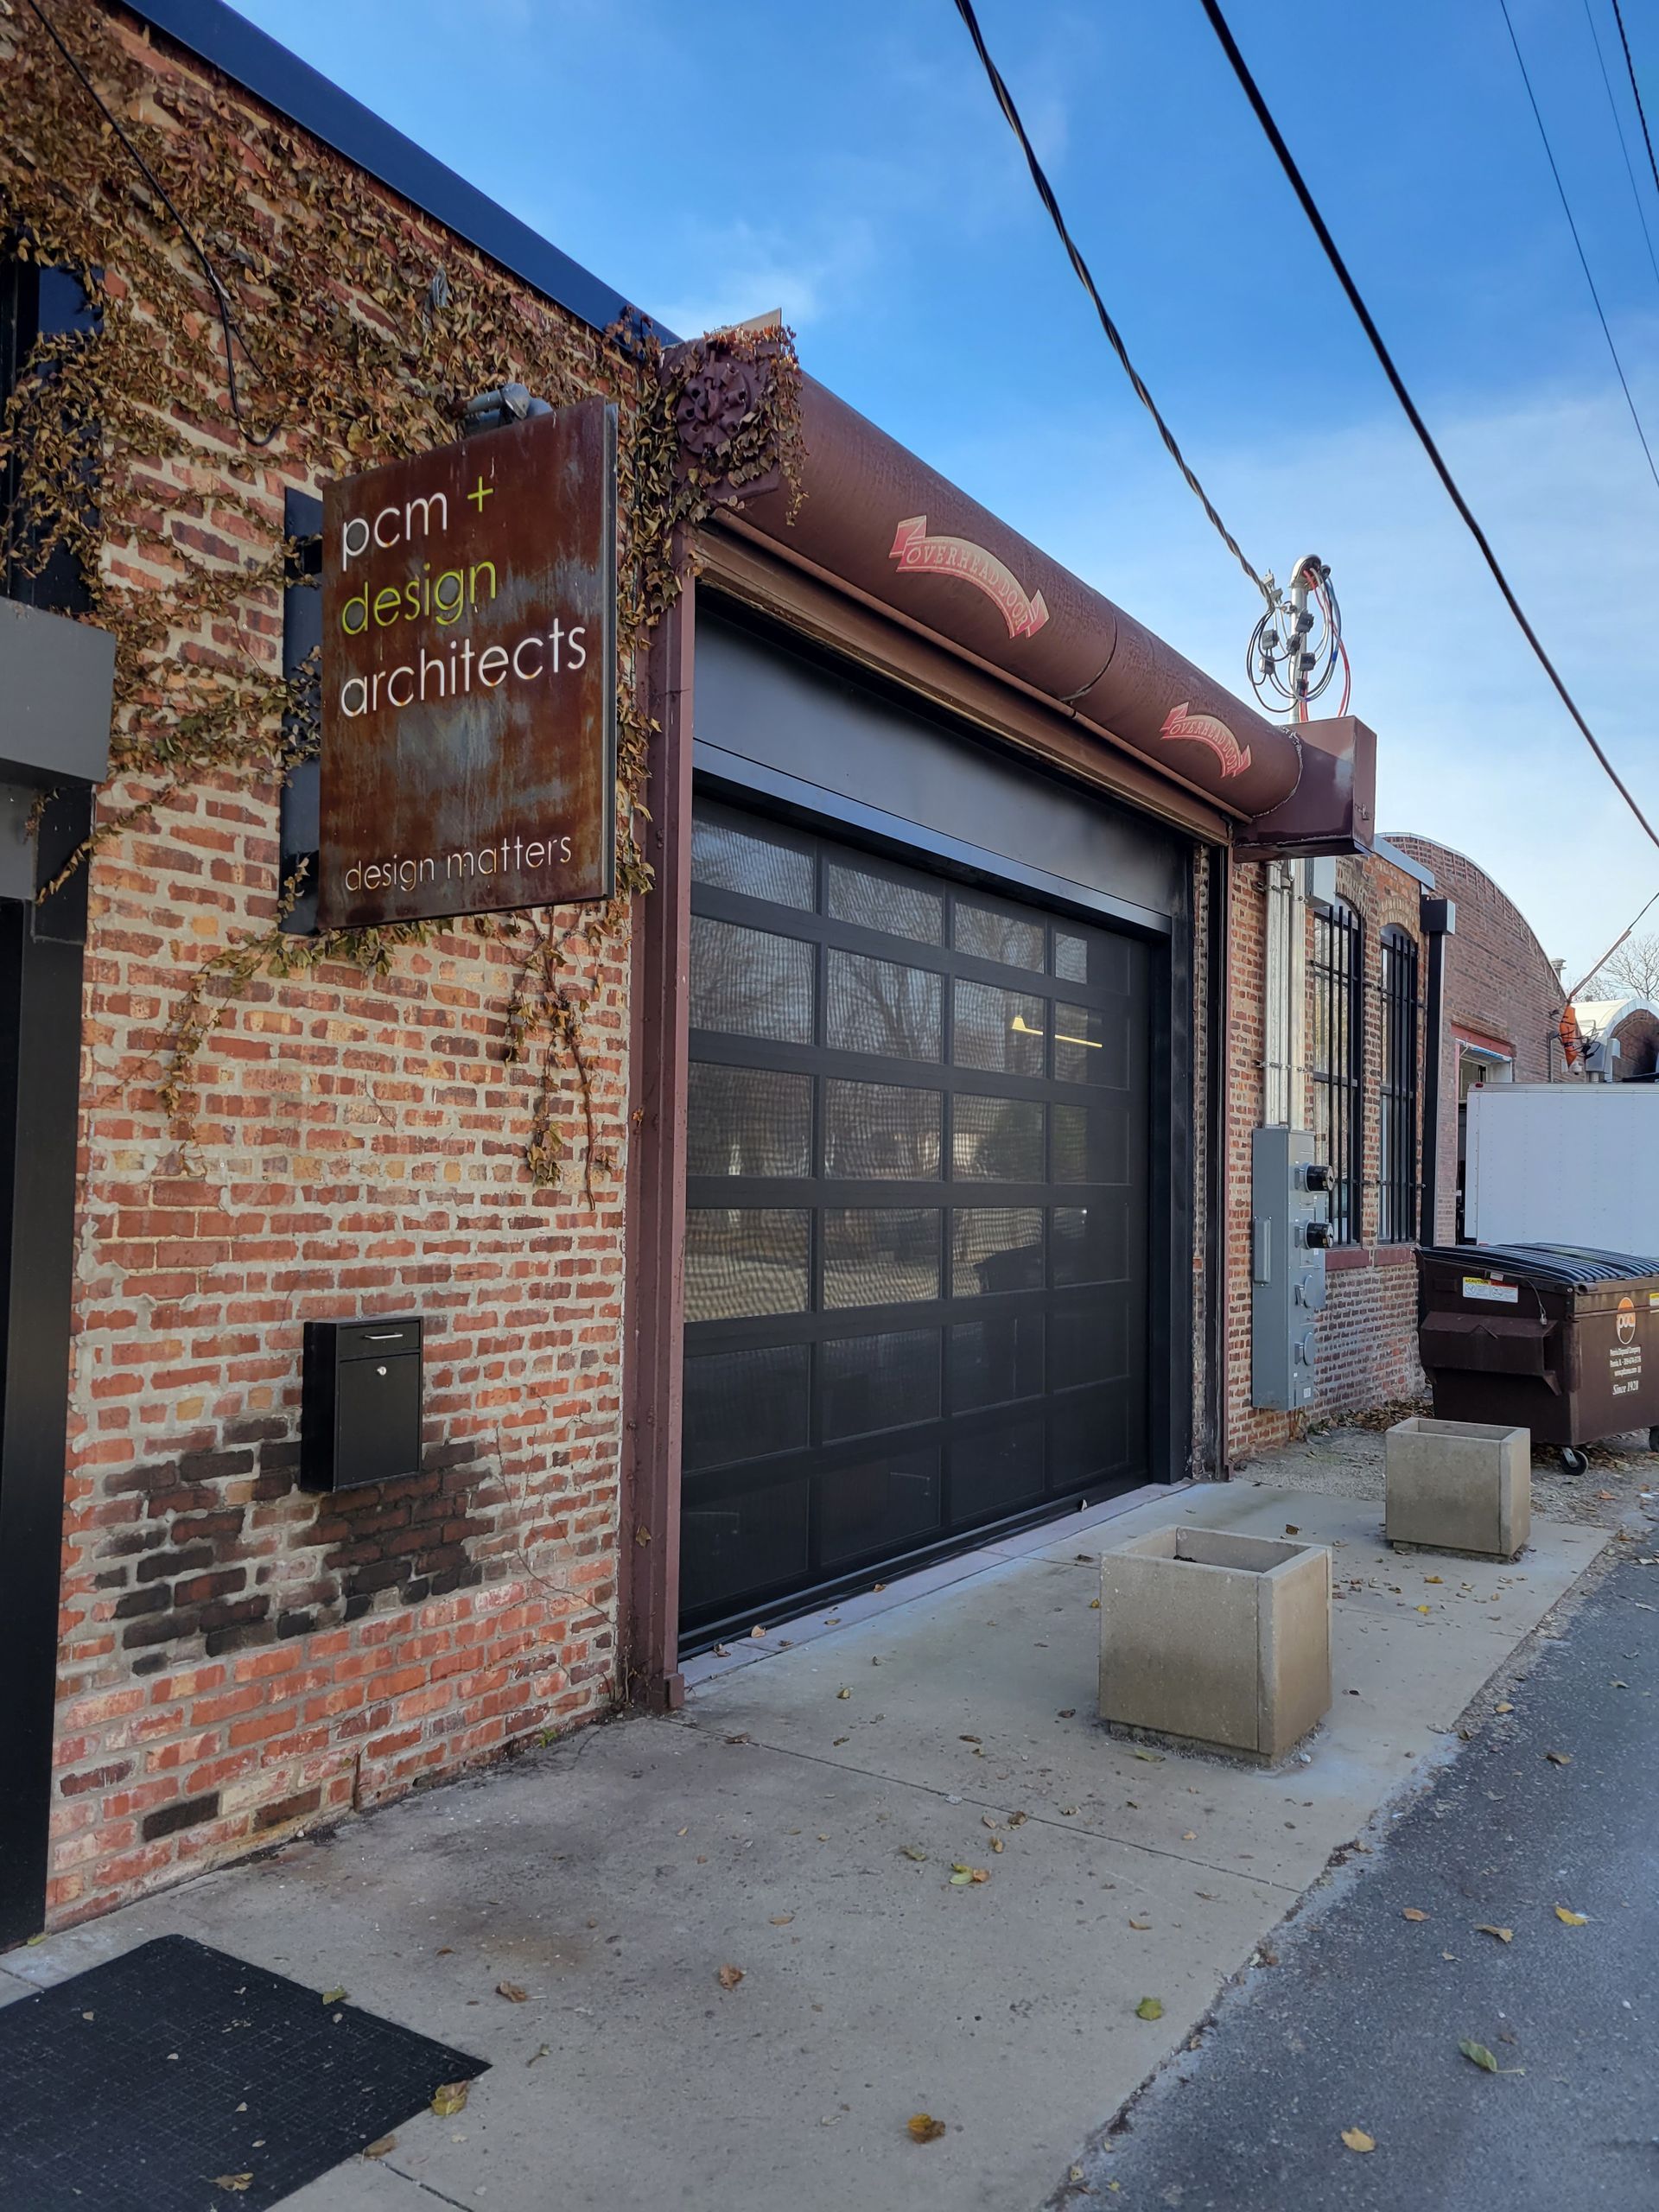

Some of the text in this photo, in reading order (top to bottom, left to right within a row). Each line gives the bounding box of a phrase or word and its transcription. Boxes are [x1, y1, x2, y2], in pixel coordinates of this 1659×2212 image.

[342, 492, 448, 572] pcm
[341, 561, 497, 636] design
[906, 545, 1028, 631] OVERHEAD DOOR
[340, 618, 588, 718] architects
[1169, 721, 1238, 774] OVERHEAD DOOR
[346, 836, 572, 892] design matters
